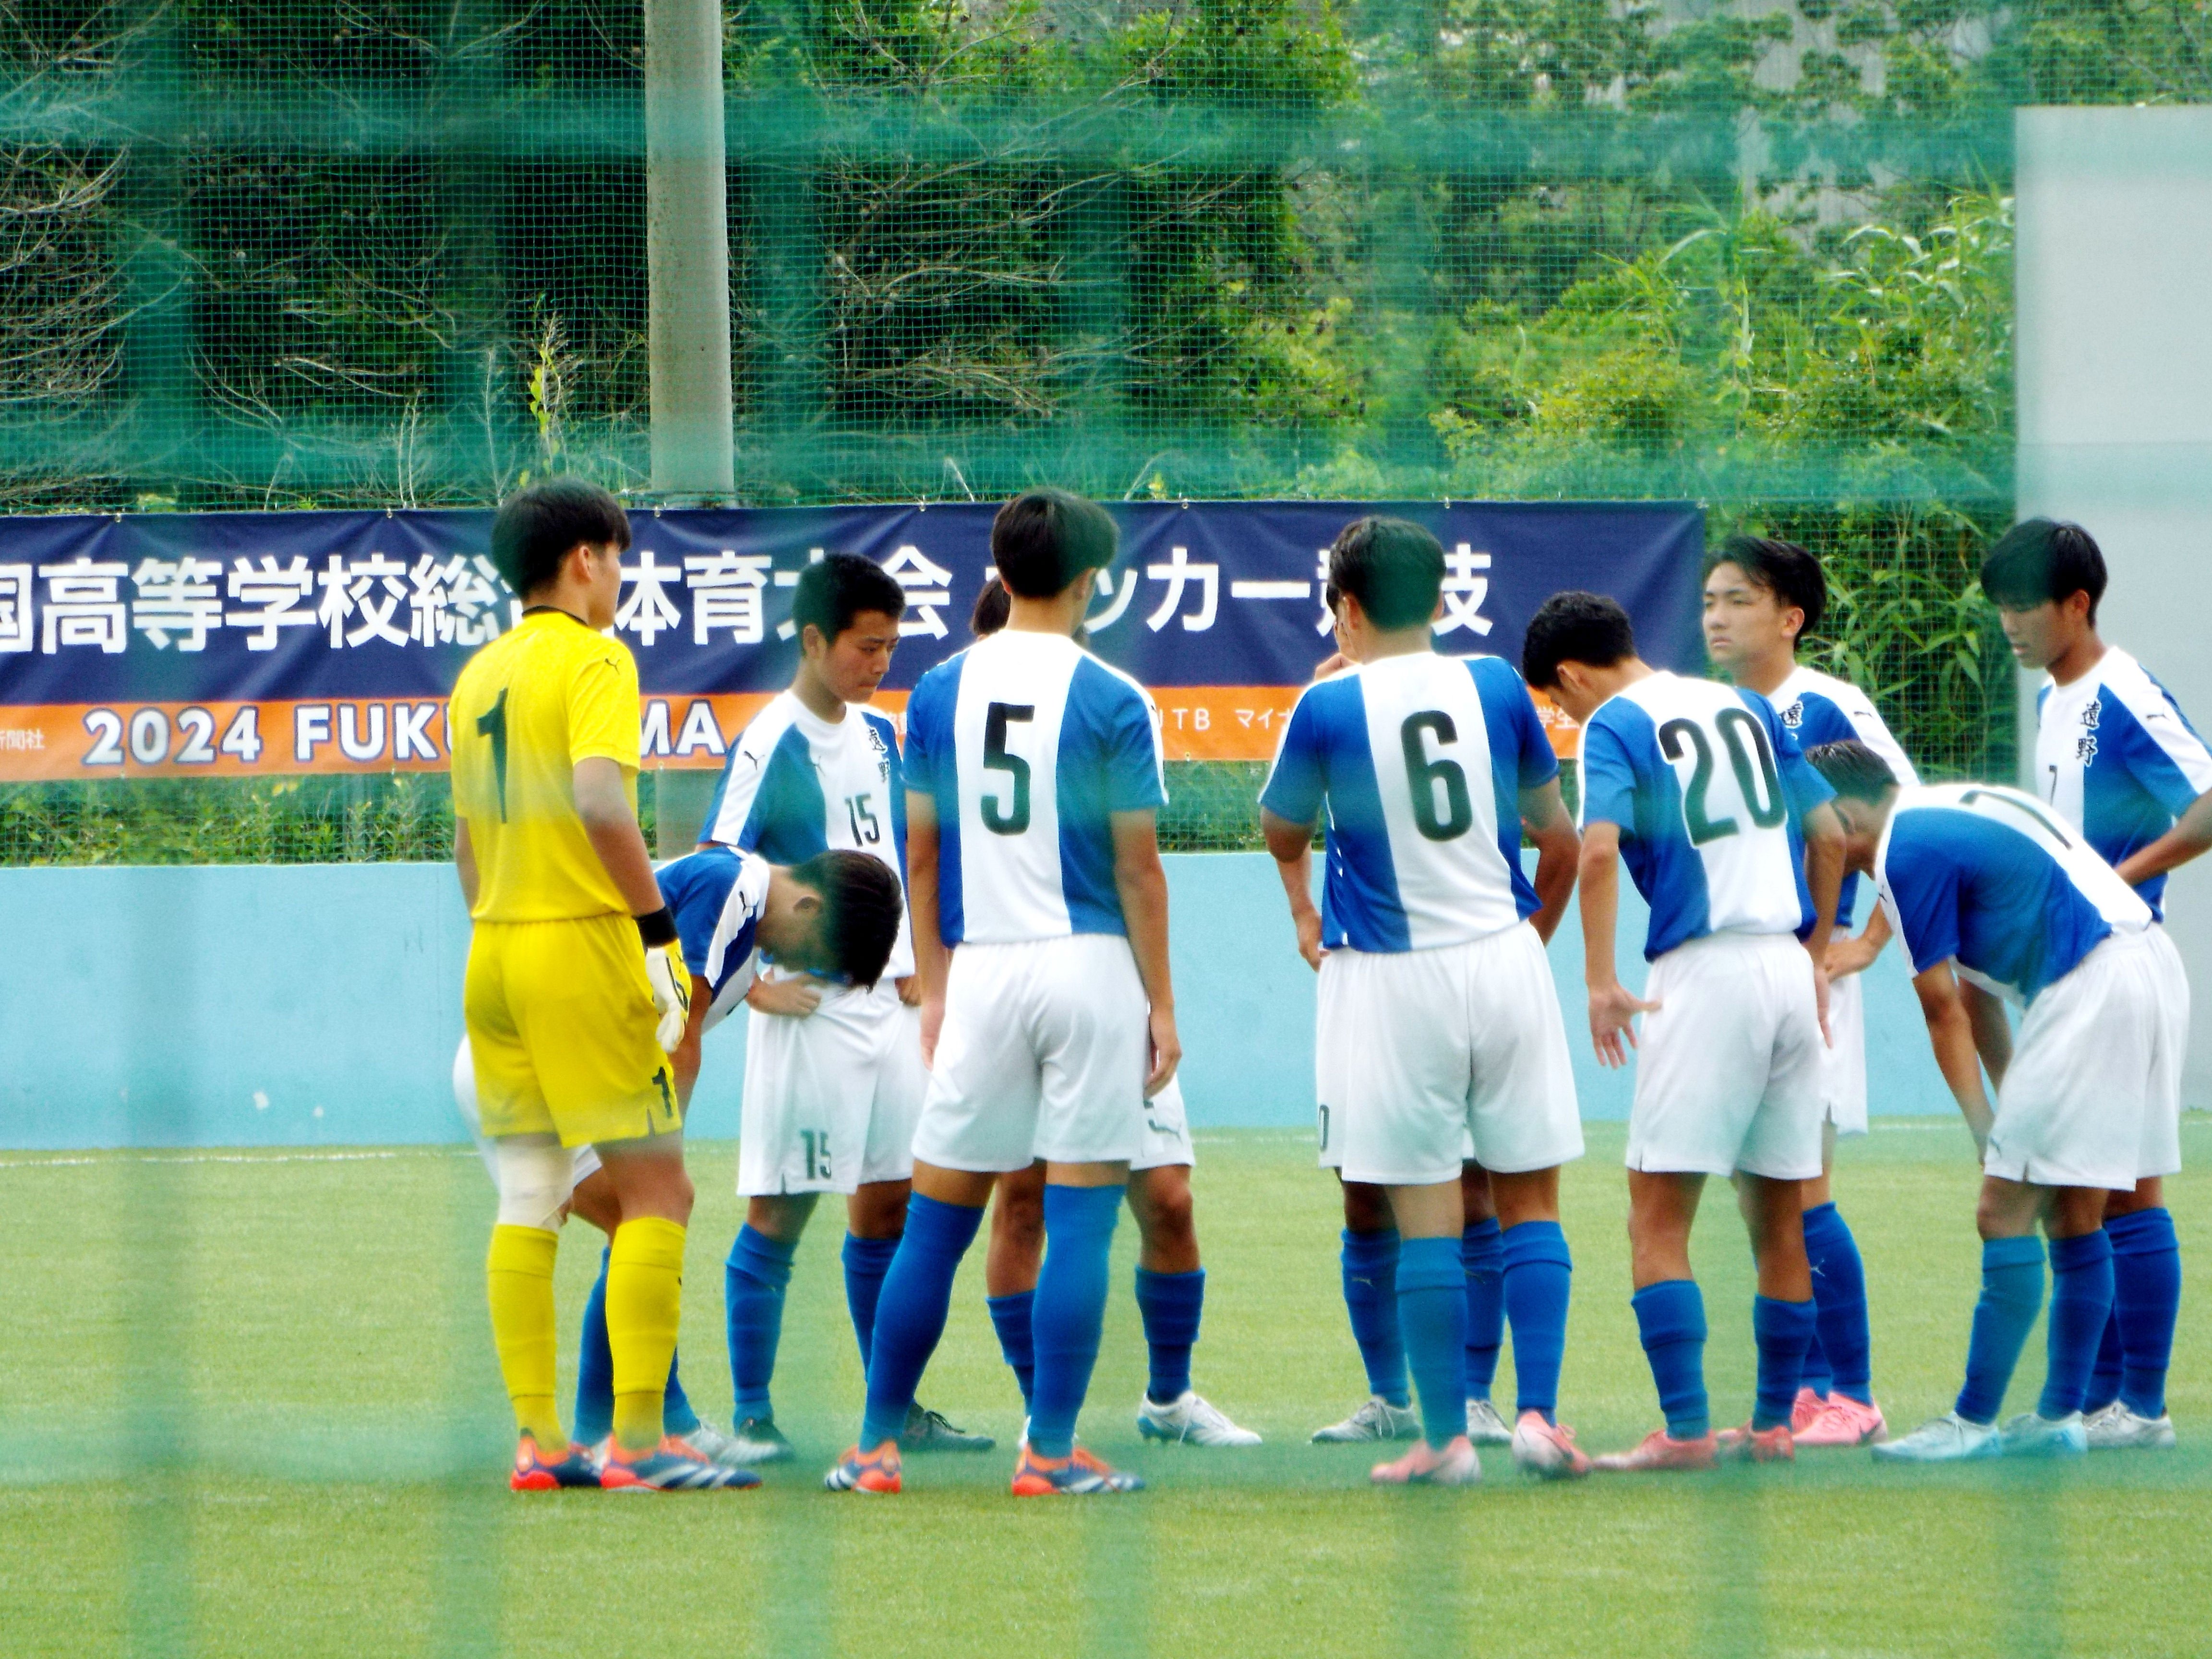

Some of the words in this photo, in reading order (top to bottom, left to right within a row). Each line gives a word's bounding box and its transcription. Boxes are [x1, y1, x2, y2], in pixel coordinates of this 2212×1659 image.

[82, 705, 262, 766] 2024
[476, 686, 508, 824] 1
[981, 701, 1035, 836] 5
[1400, 710, 1473, 842] 6
[1658, 707, 1789, 849] 20
[845, 793, 879, 848] 15
[652, 1066, 672, 1118] 1
[801, 1130, 832, 1180] 15
